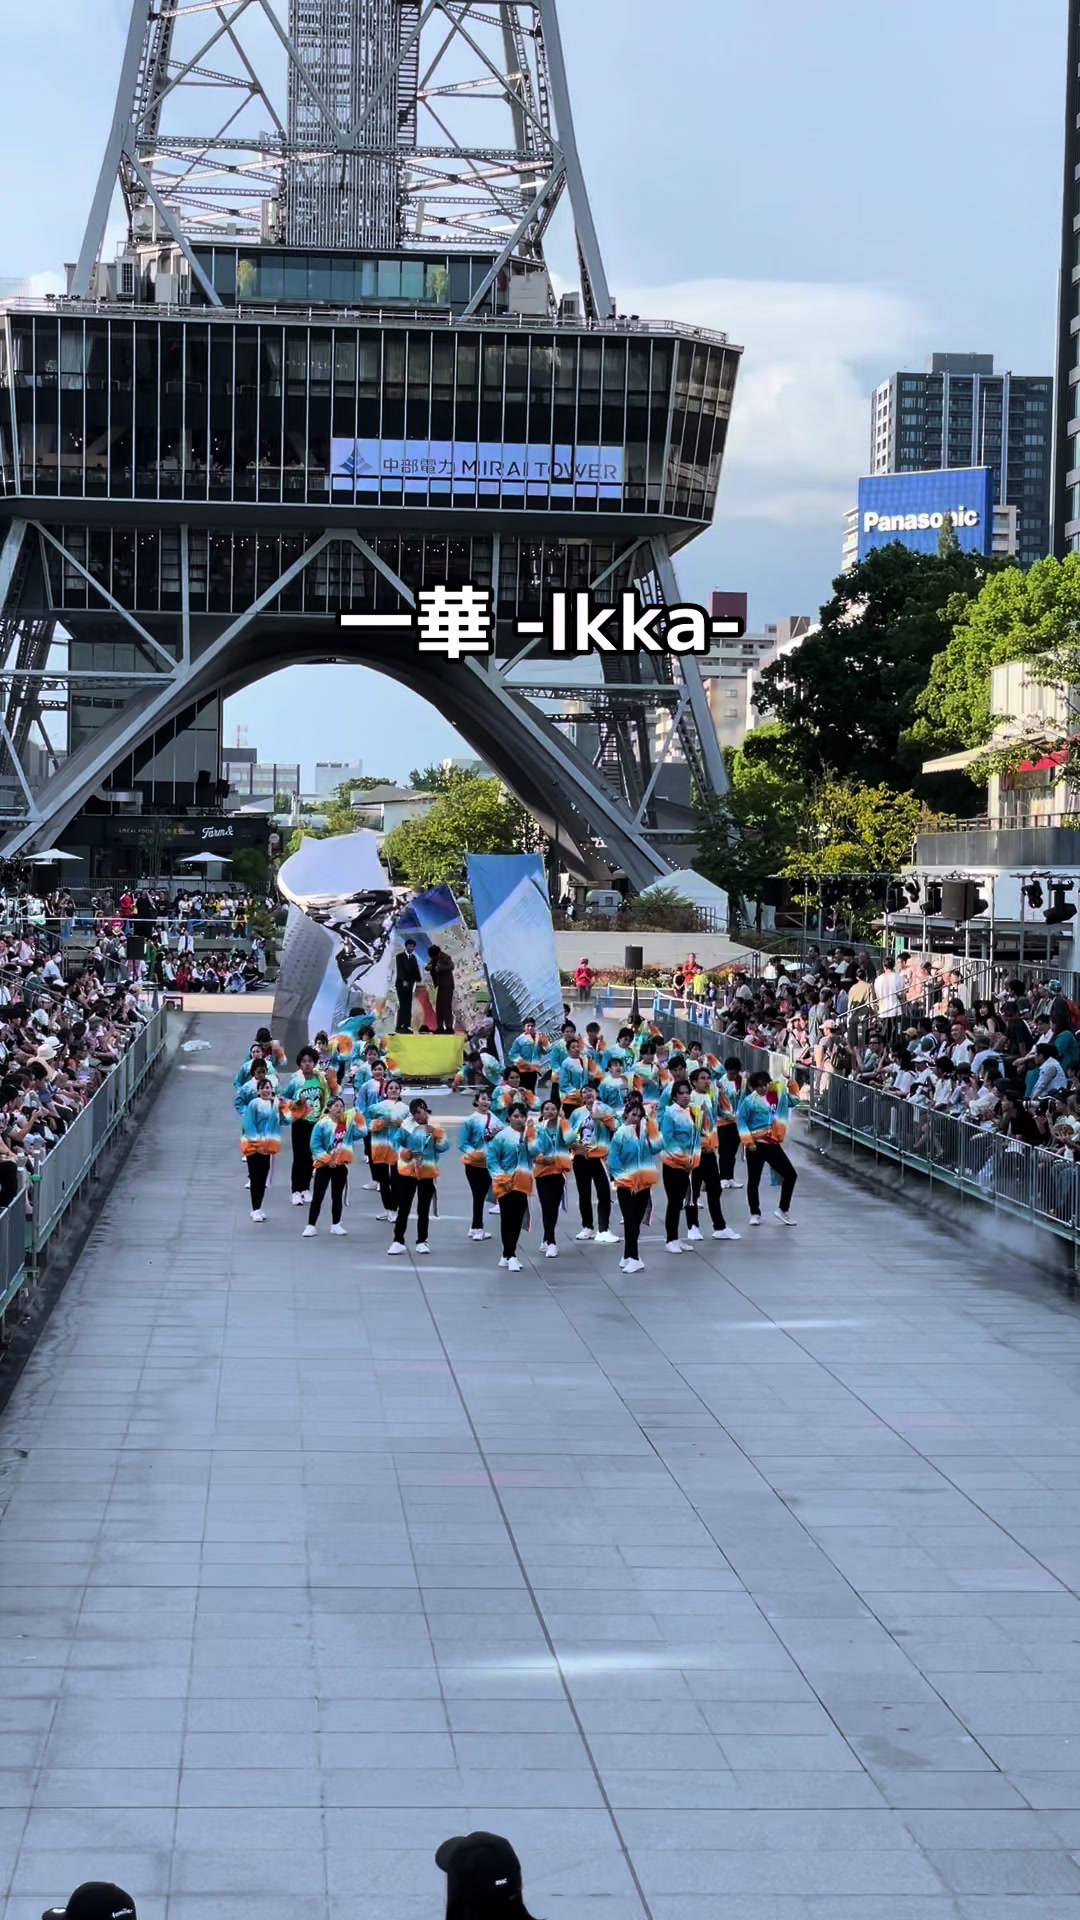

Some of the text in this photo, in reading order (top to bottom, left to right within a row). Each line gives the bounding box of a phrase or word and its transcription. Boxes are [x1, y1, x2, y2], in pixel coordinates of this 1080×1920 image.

[383, 457, 456, 475] 中部電力
[461, 459, 617, 480] MIRAI TOWER
